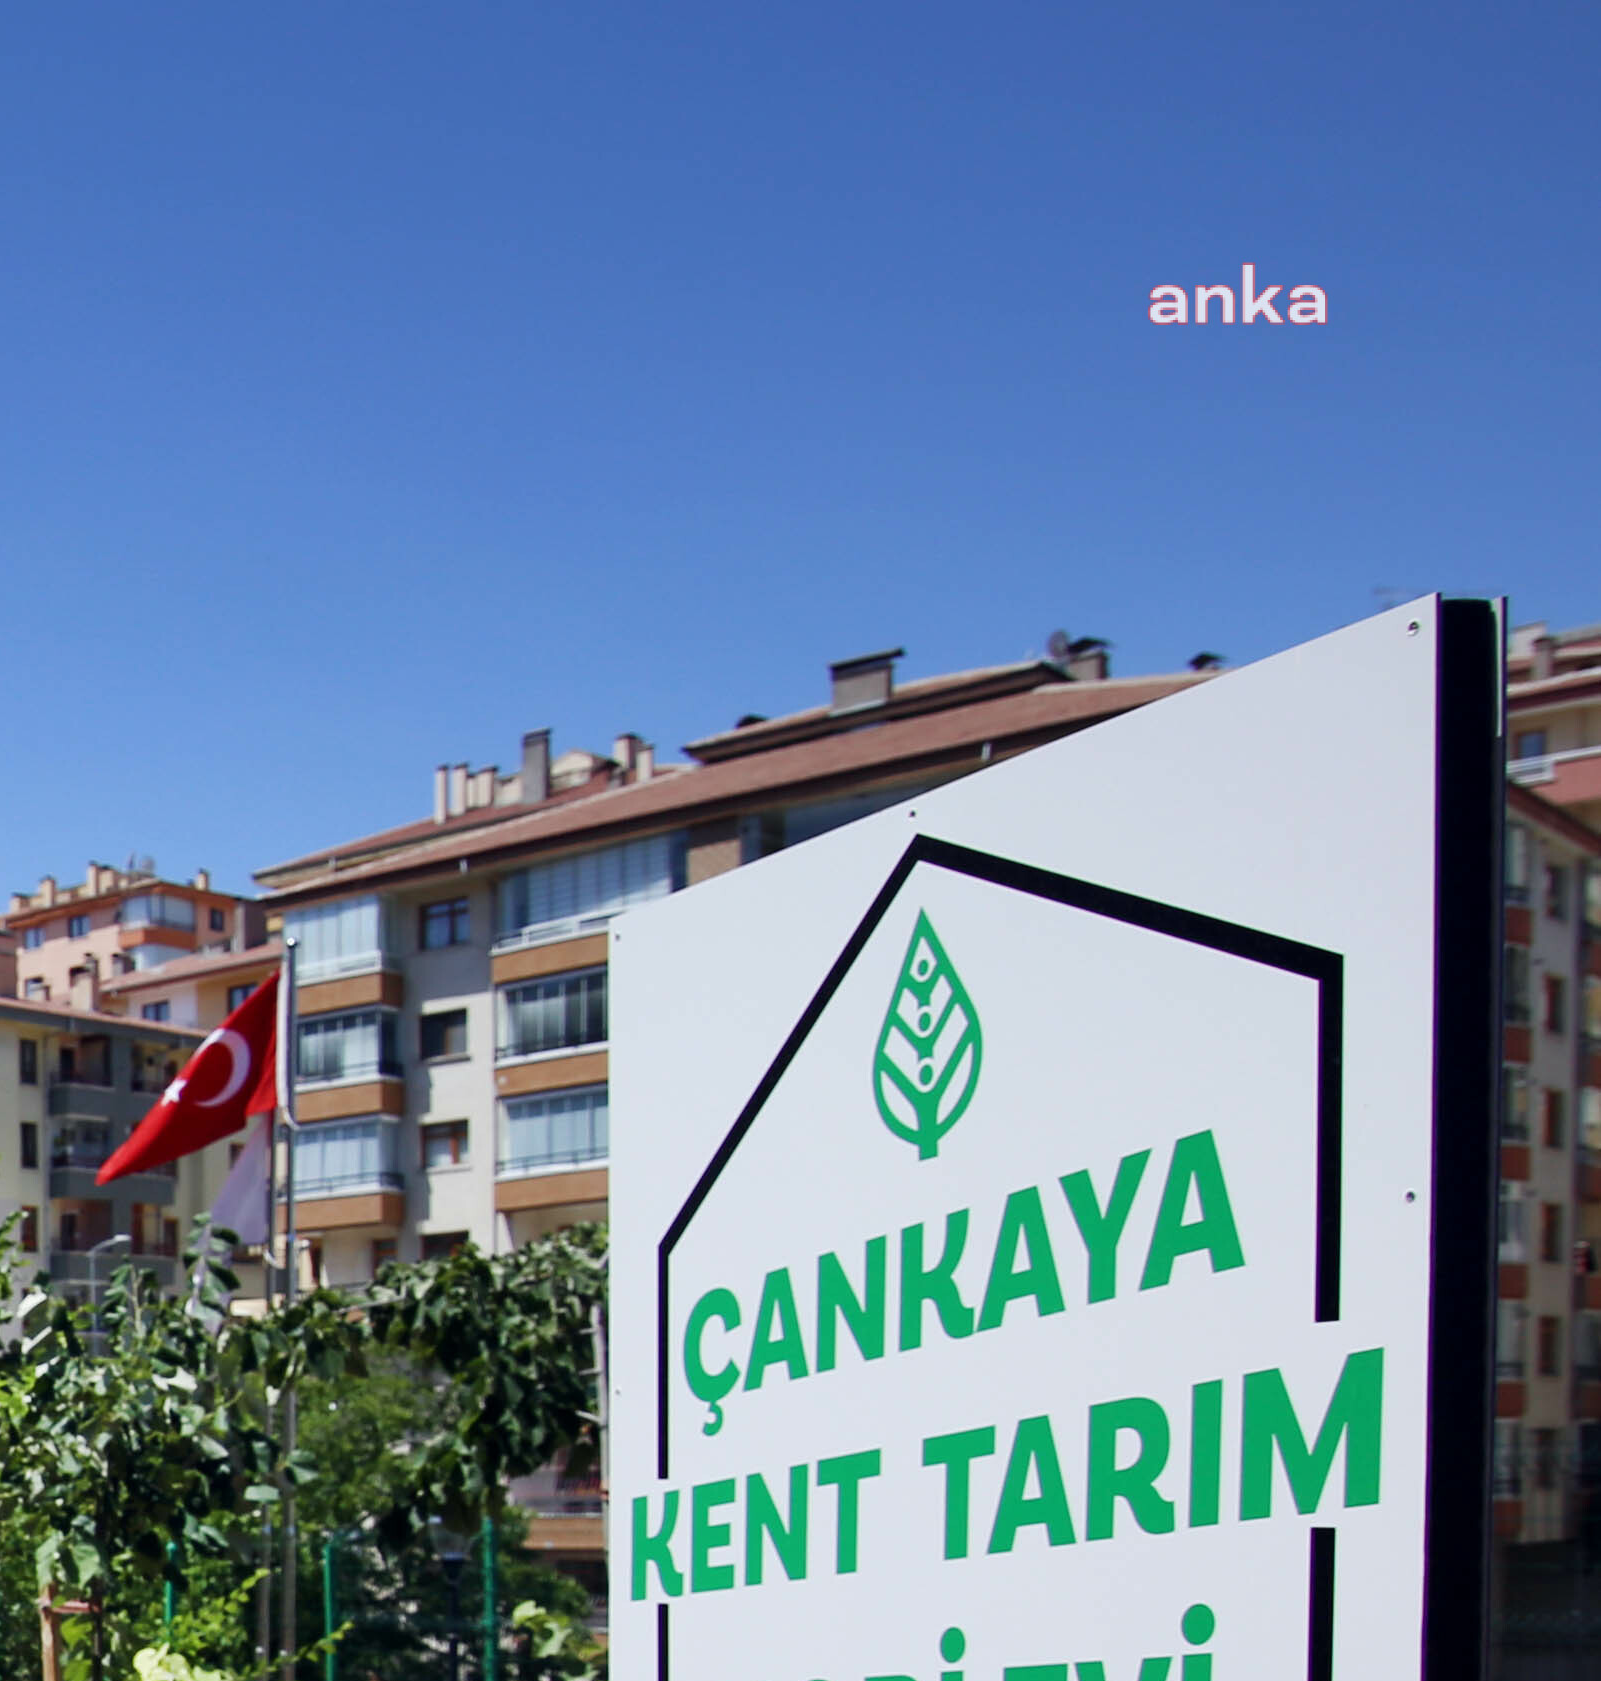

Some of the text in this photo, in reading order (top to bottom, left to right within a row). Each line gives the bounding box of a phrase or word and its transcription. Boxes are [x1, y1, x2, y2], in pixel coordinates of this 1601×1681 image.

[683, 1129, 1246, 1436] ÇANKAYA
[631, 1347, 1385, 1601] KENT TARIM
